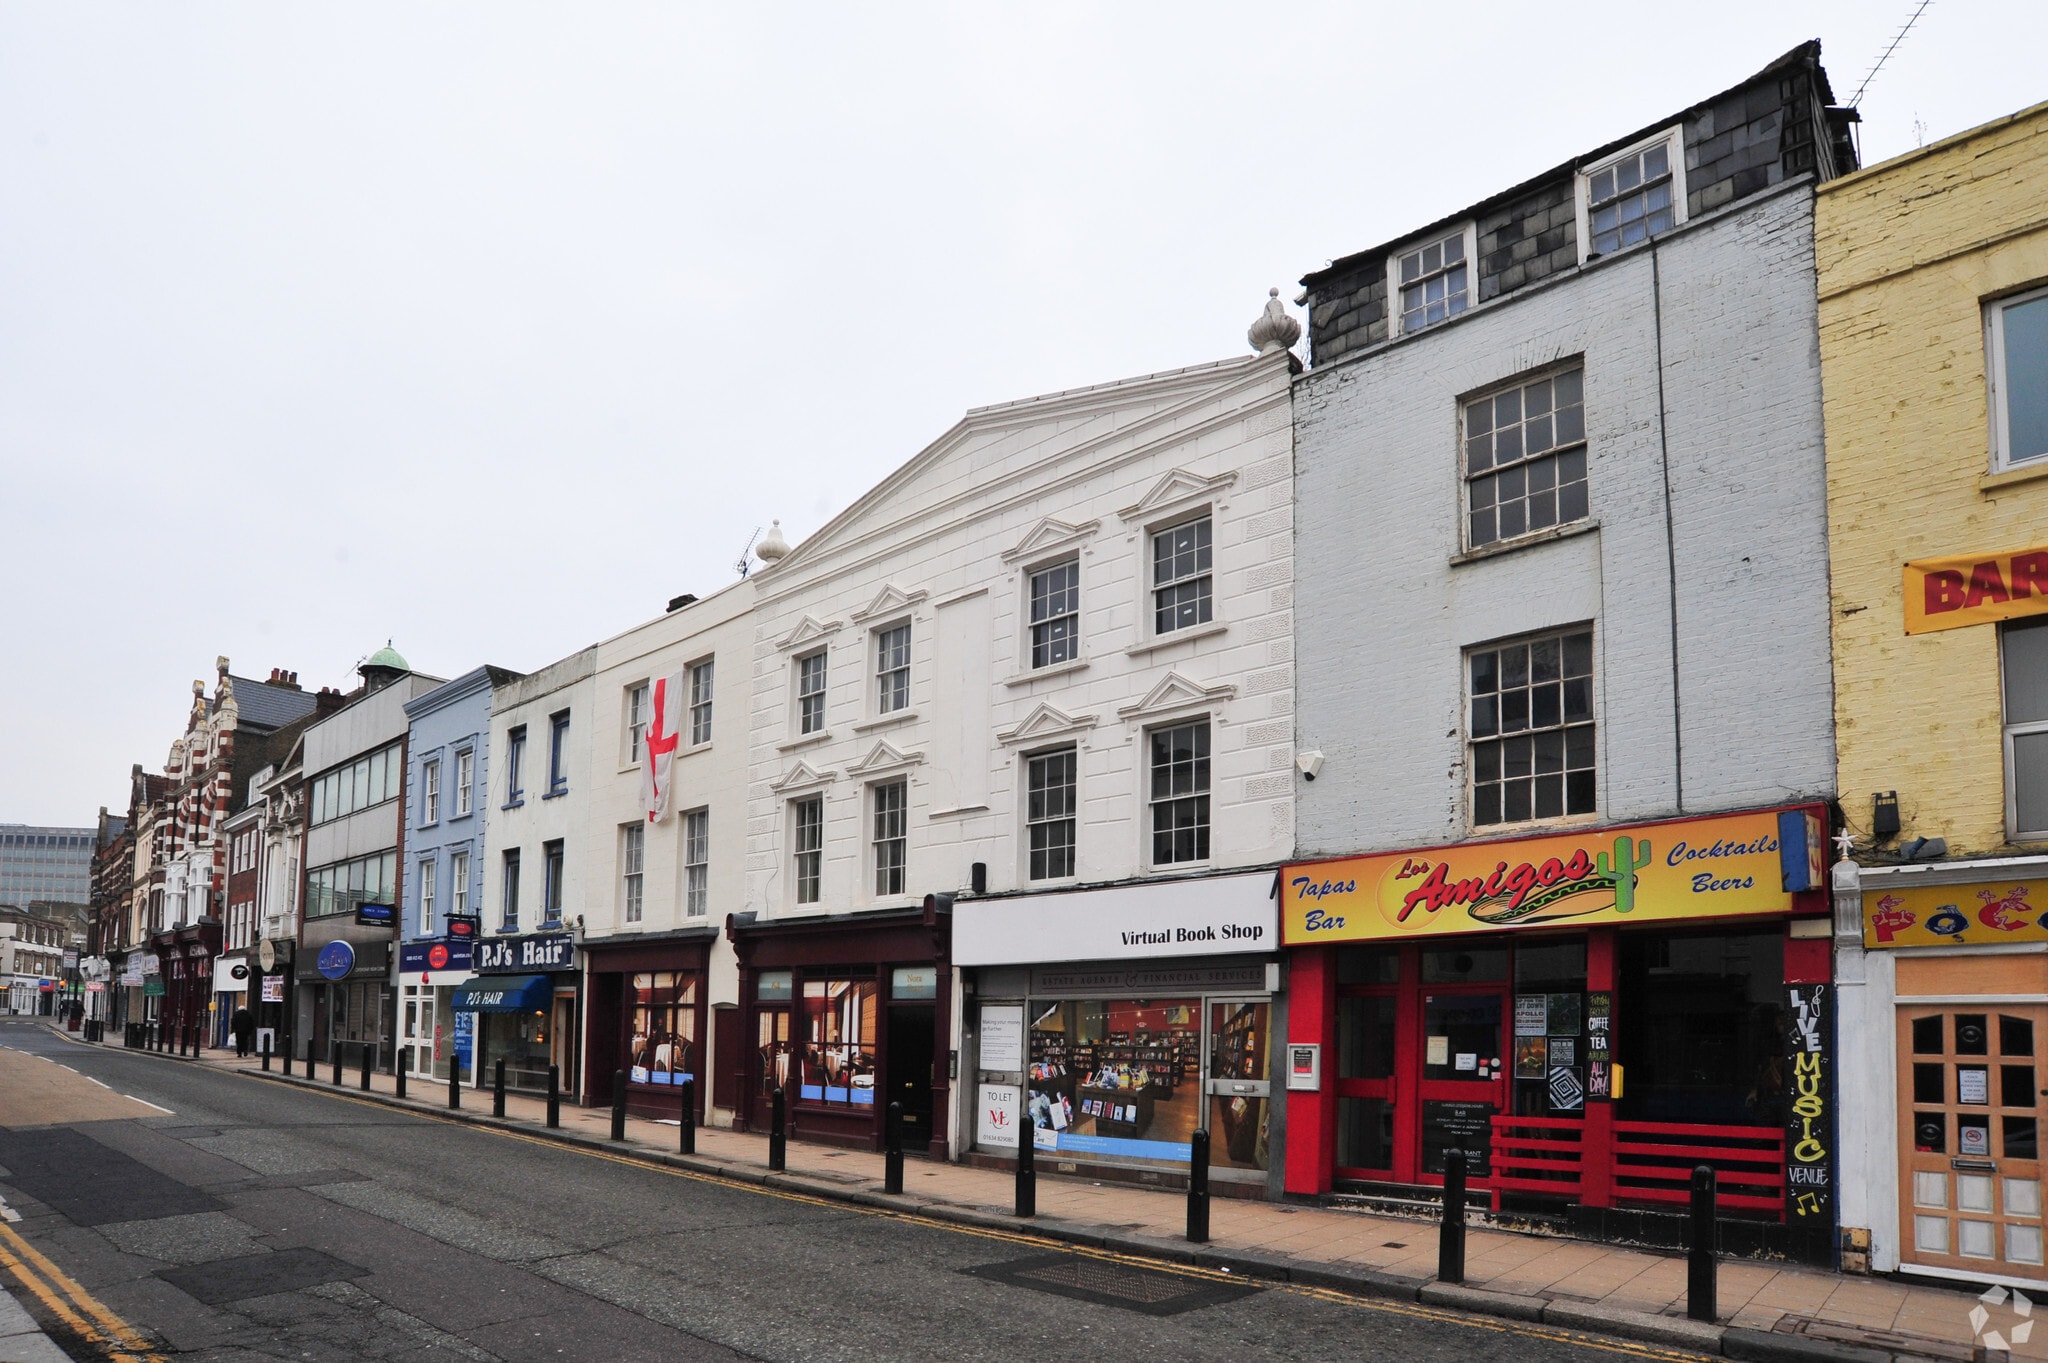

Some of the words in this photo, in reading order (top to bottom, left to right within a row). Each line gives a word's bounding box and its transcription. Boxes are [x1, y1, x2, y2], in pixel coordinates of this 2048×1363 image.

[1667, 834, 1779, 867] Cocktails
[1395, 858, 1429, 880] Los
[1292, 876, 1357, 901] Tapas
[1396, 848, 1594, 923] Amigos
[1692, 872, 1754, 893] Beers
[1305, 909, 1346, 932] Bar
[1872, 887, 2048, 943] POC
[1121, 929, 1171, 946] Virtual
[1176, 925, 1216, 942] Book
[1221, 924, 1263, 941] Shop
[481, 940, 513, 967] P.J's
[522, 940, 563, 965] Hair
[1042, 976, 1074, 985] ESTATE
[1081, 975, 1119, 985] AGENTS
[1125, 972, 1138, 987] &
[1143, 973, 1199, 983] FINANCIAL
[1208, 971, 1263, 981] SERVICES
[466, 992, 481, 1006] PJ's
[482, 991, 503, 1005] HAIR
[1589, 1017, 1609, 1030] COFFEE
[1790, 989, 1822, 1052] LIVE
[1590, 1037, 1607, 1049] TEA
[1591, 1062, 1604, 1077] ALL
[988, 1092, 997, 1101] TO
[999, 1093, 1012, 1102] LET
[1792, 1052, 1826, 1162] MUSIC
[1789, 1167, 1829, 1185] VENUE
